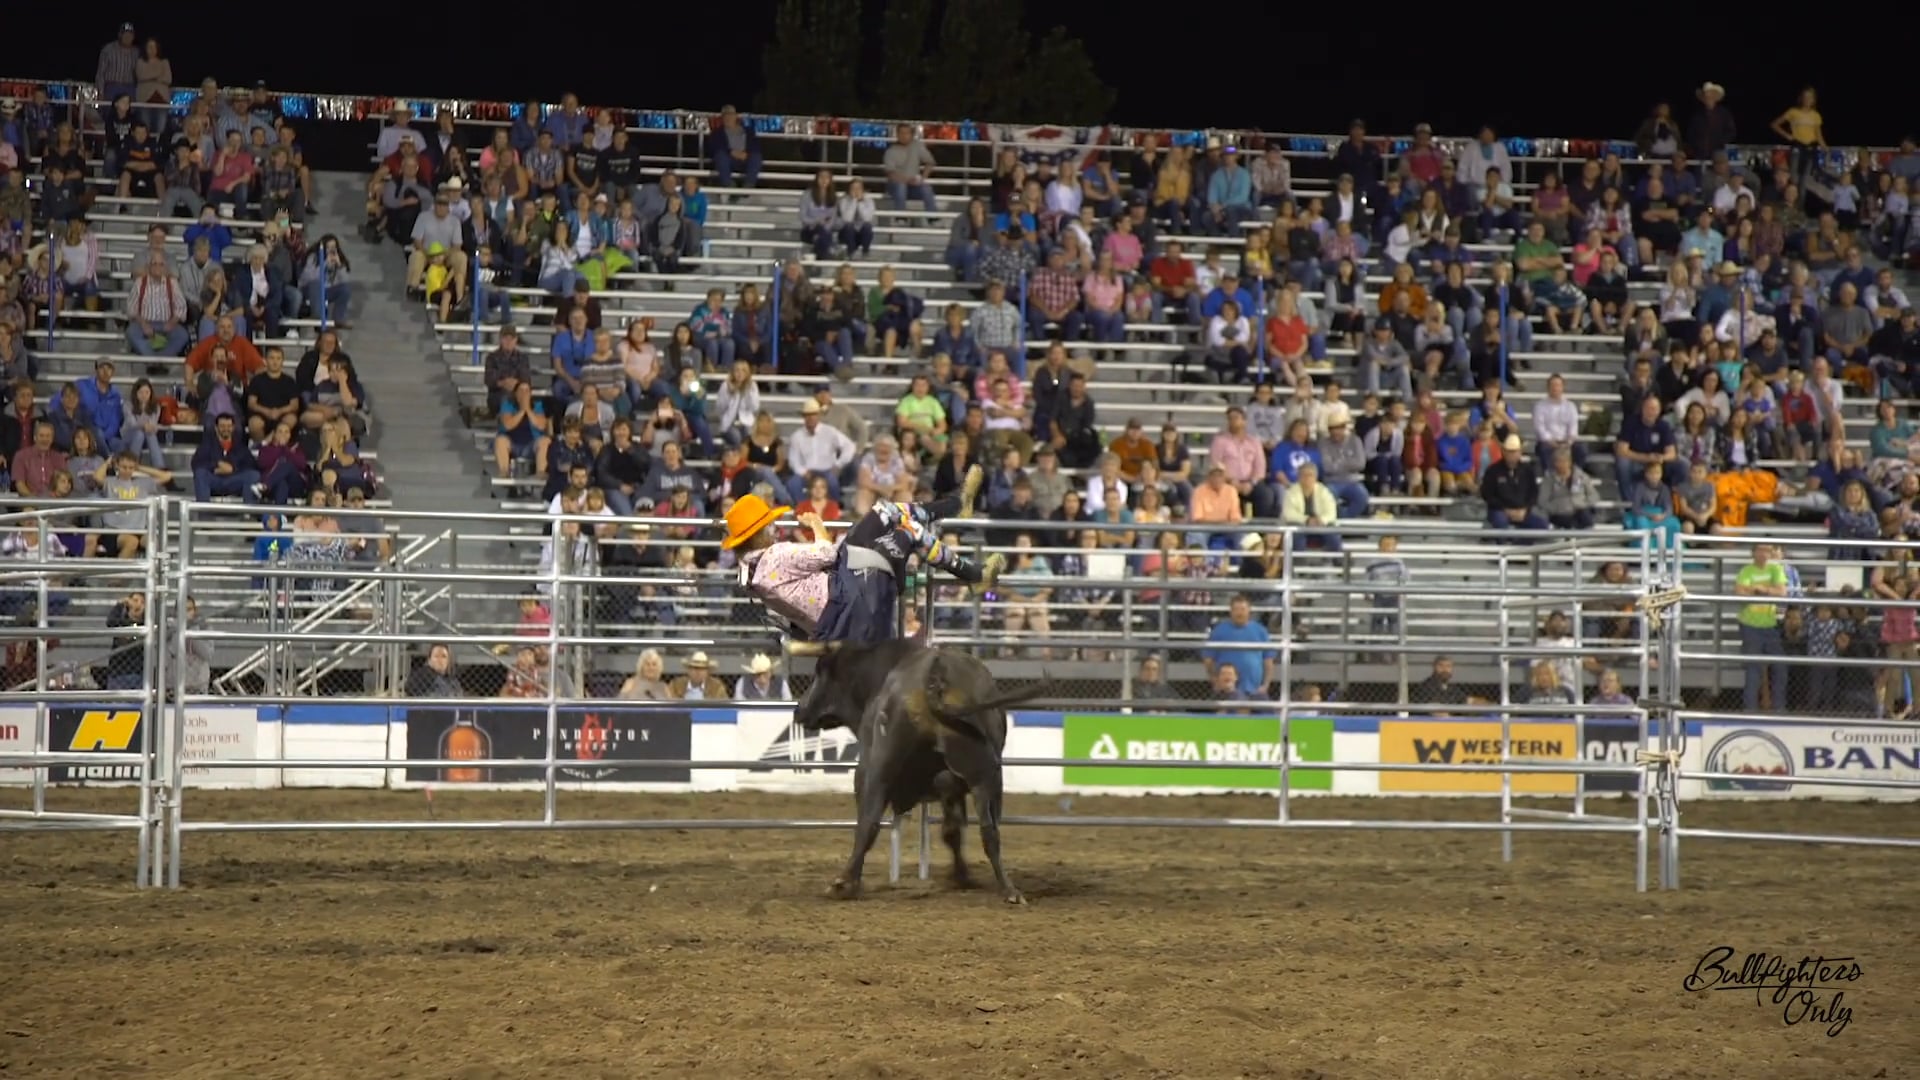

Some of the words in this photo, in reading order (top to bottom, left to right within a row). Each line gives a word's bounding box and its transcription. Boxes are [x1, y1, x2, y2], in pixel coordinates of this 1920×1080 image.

[185, 733, 241, 745] quipment
[533, 728, 650, 741] PNDLETON
[1127, 740, 1201, 761] DELTA
[1461, 739, 1563, 756] WESTERN
[1586, 740, 1640, 762] CAT
